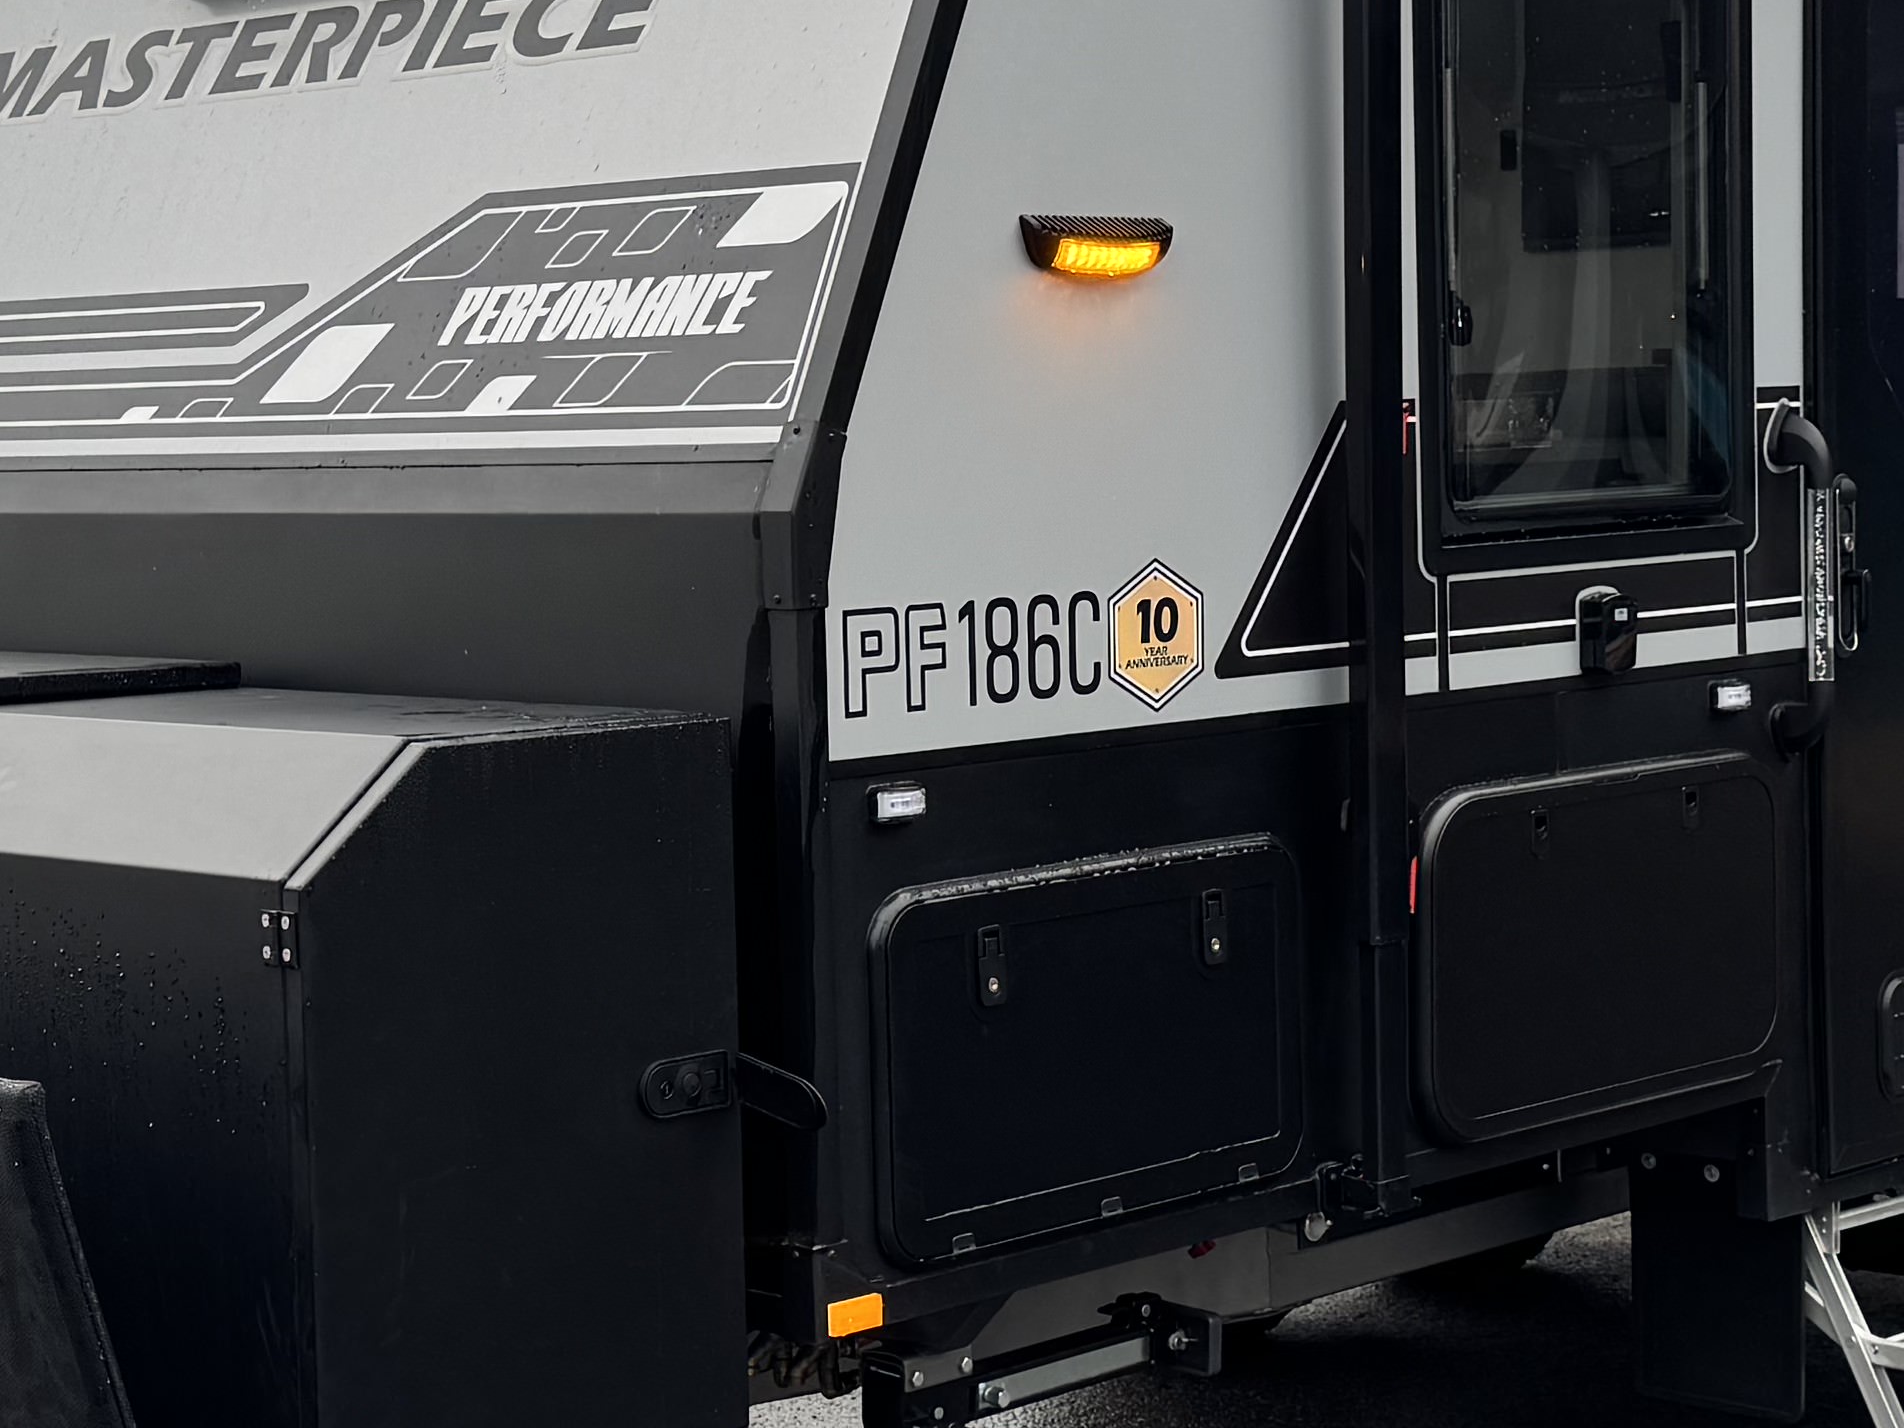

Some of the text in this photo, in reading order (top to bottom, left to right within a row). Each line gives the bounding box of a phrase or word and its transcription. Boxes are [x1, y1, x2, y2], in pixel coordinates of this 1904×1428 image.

[437, 269, 771, 346] PERFORMANCE
[1136, 596, 1179, 644] 10
[842, 590, 1103, 719] PF186C
[1124, 654, 1189, 670] ANNIVERSARY
[1144, 645, 1168, 657] YEAR
